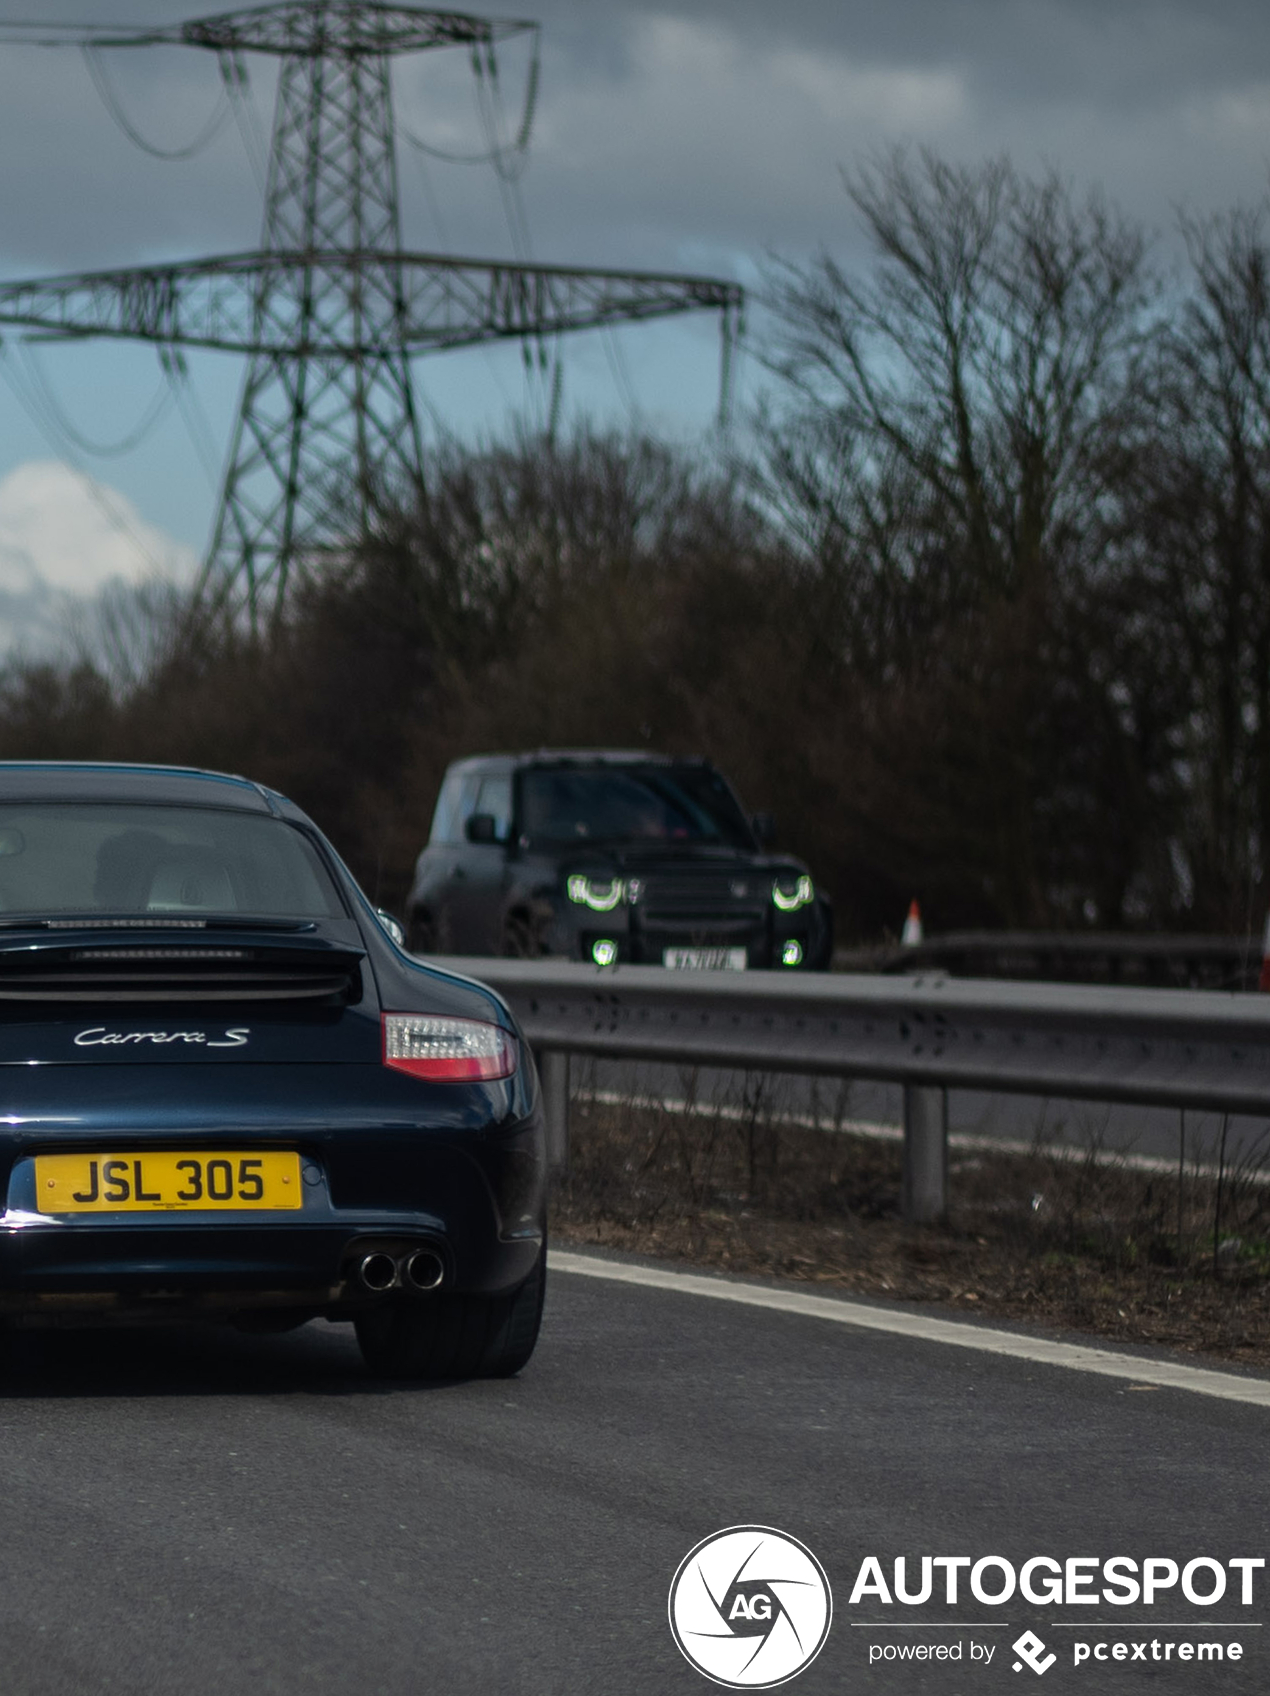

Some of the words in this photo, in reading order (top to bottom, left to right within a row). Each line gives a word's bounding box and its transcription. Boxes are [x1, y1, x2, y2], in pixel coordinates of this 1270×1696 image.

[73, 1027, 206, 1046] Carrera
[206, 1027, 251, 1047] S
[72, 1160, 161, 1203] JSL
[176, 1159, 264, 1201] 305
